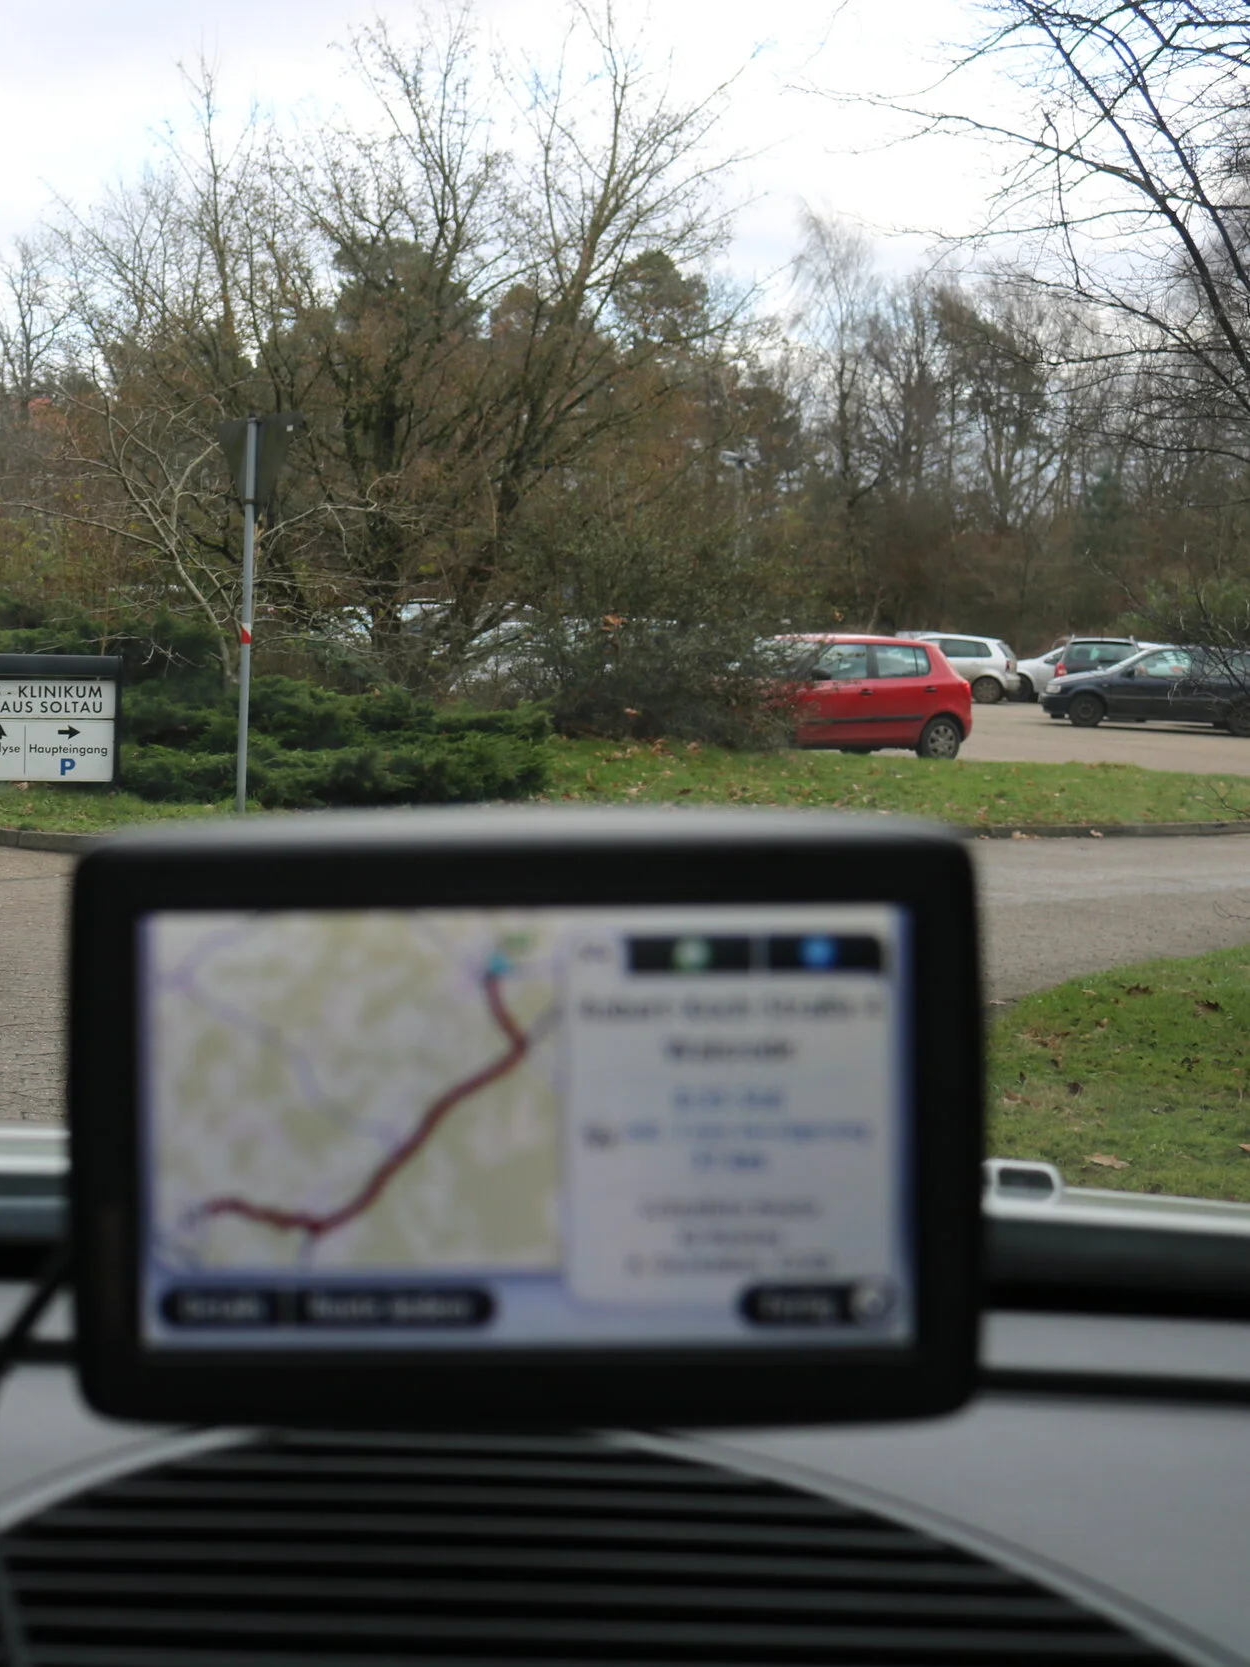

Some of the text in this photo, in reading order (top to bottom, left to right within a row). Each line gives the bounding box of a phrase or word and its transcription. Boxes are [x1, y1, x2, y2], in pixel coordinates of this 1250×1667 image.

[18, 685, 102, 698] KLINIKUM
[40, 701, 103, 713] SOLTAU
[29, 744, 108, 757] Haupteingang
[60, 758, 76, 776] P
